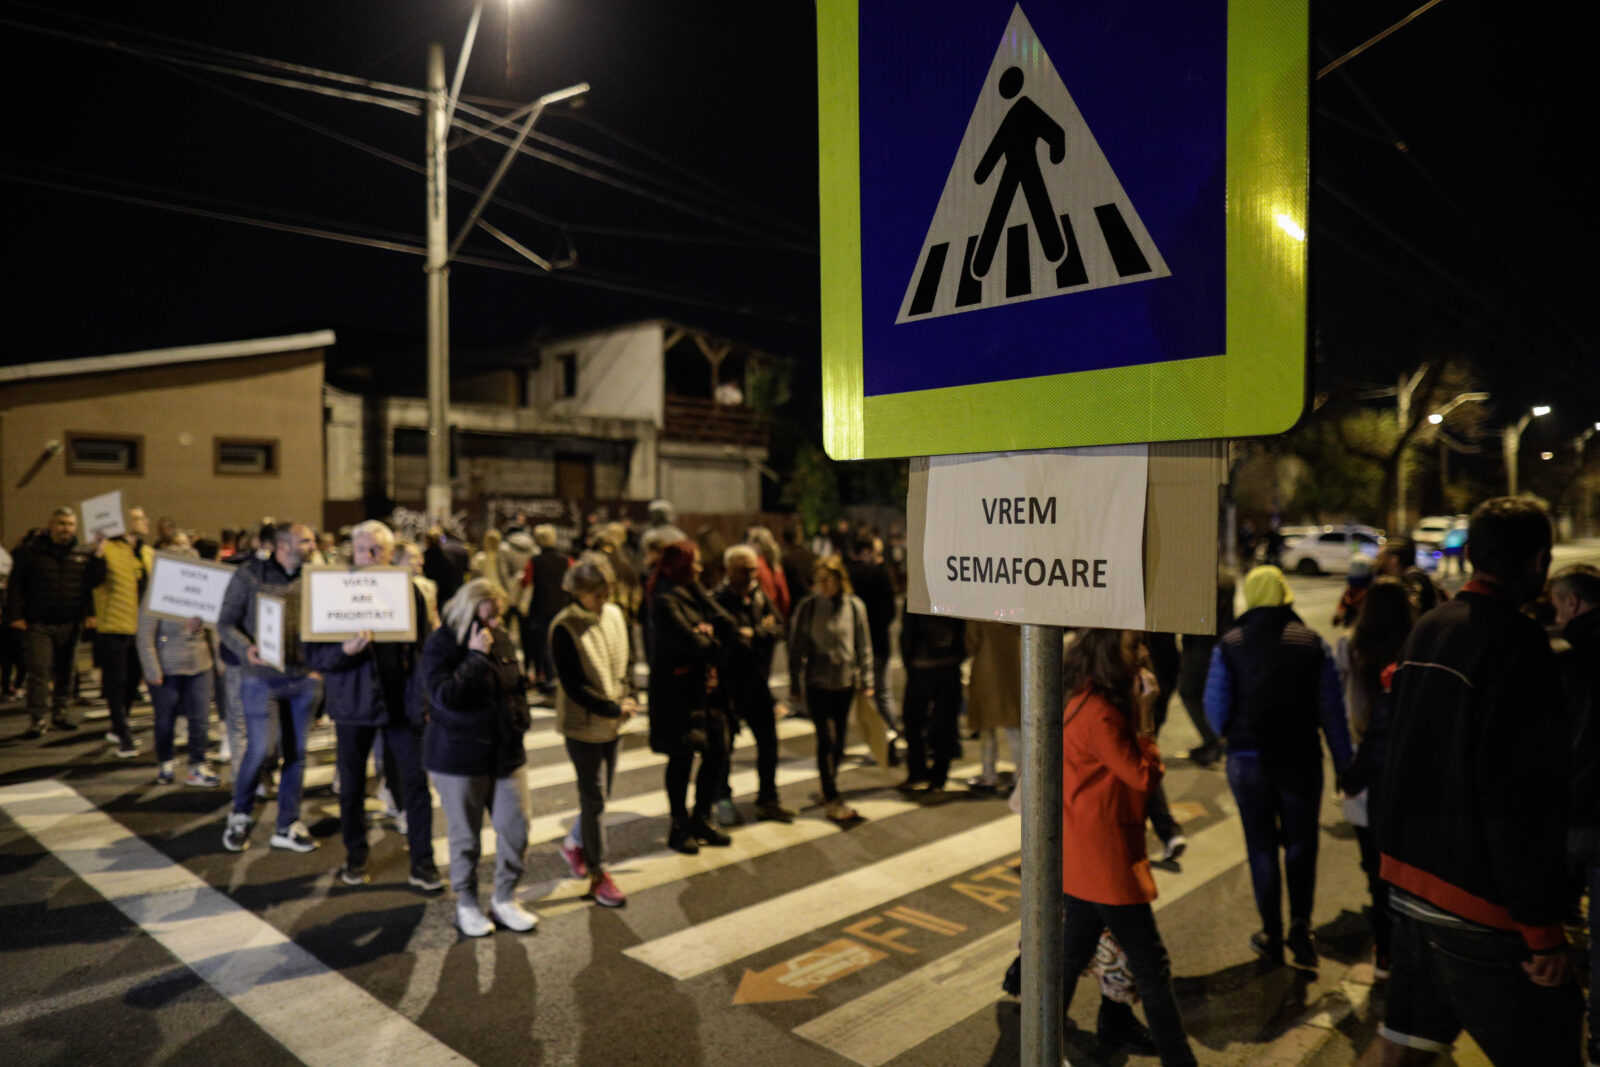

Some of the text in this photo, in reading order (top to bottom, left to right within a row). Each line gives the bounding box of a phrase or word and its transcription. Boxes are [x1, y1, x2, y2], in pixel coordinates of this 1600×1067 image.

[982, 496, 1056, 525] VREM
[946, 555, 1107, 588] SEMAFOARE
[351, 593, 372, 603] ARE
[327, 610, 395, 621] PRIORITATE
